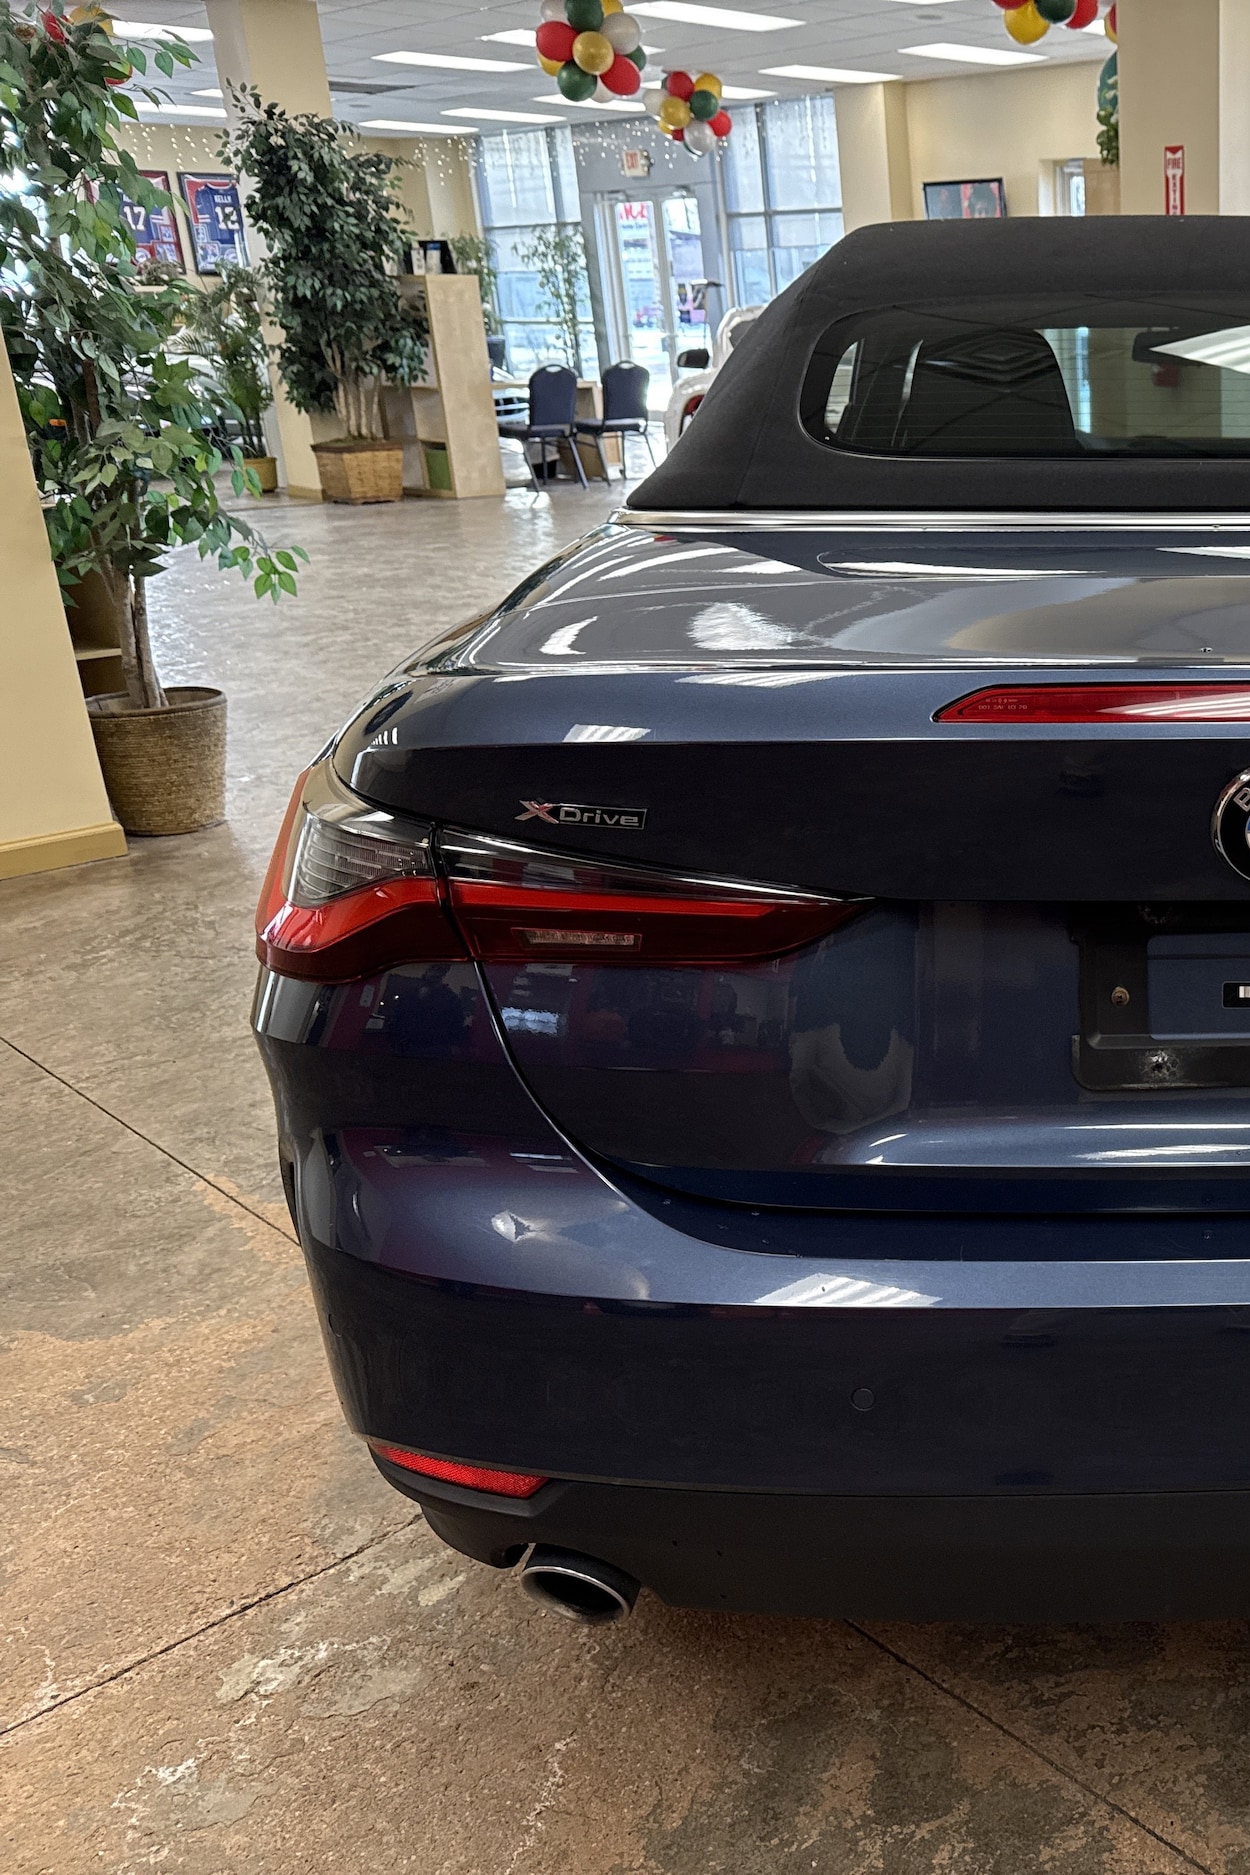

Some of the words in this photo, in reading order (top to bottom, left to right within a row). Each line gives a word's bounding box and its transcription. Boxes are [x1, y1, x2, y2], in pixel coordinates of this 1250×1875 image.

[1167, 157, 1182, 169] FIRE
[123, 206, 146, 231] 17
[215, 206, 240, 230] 12
